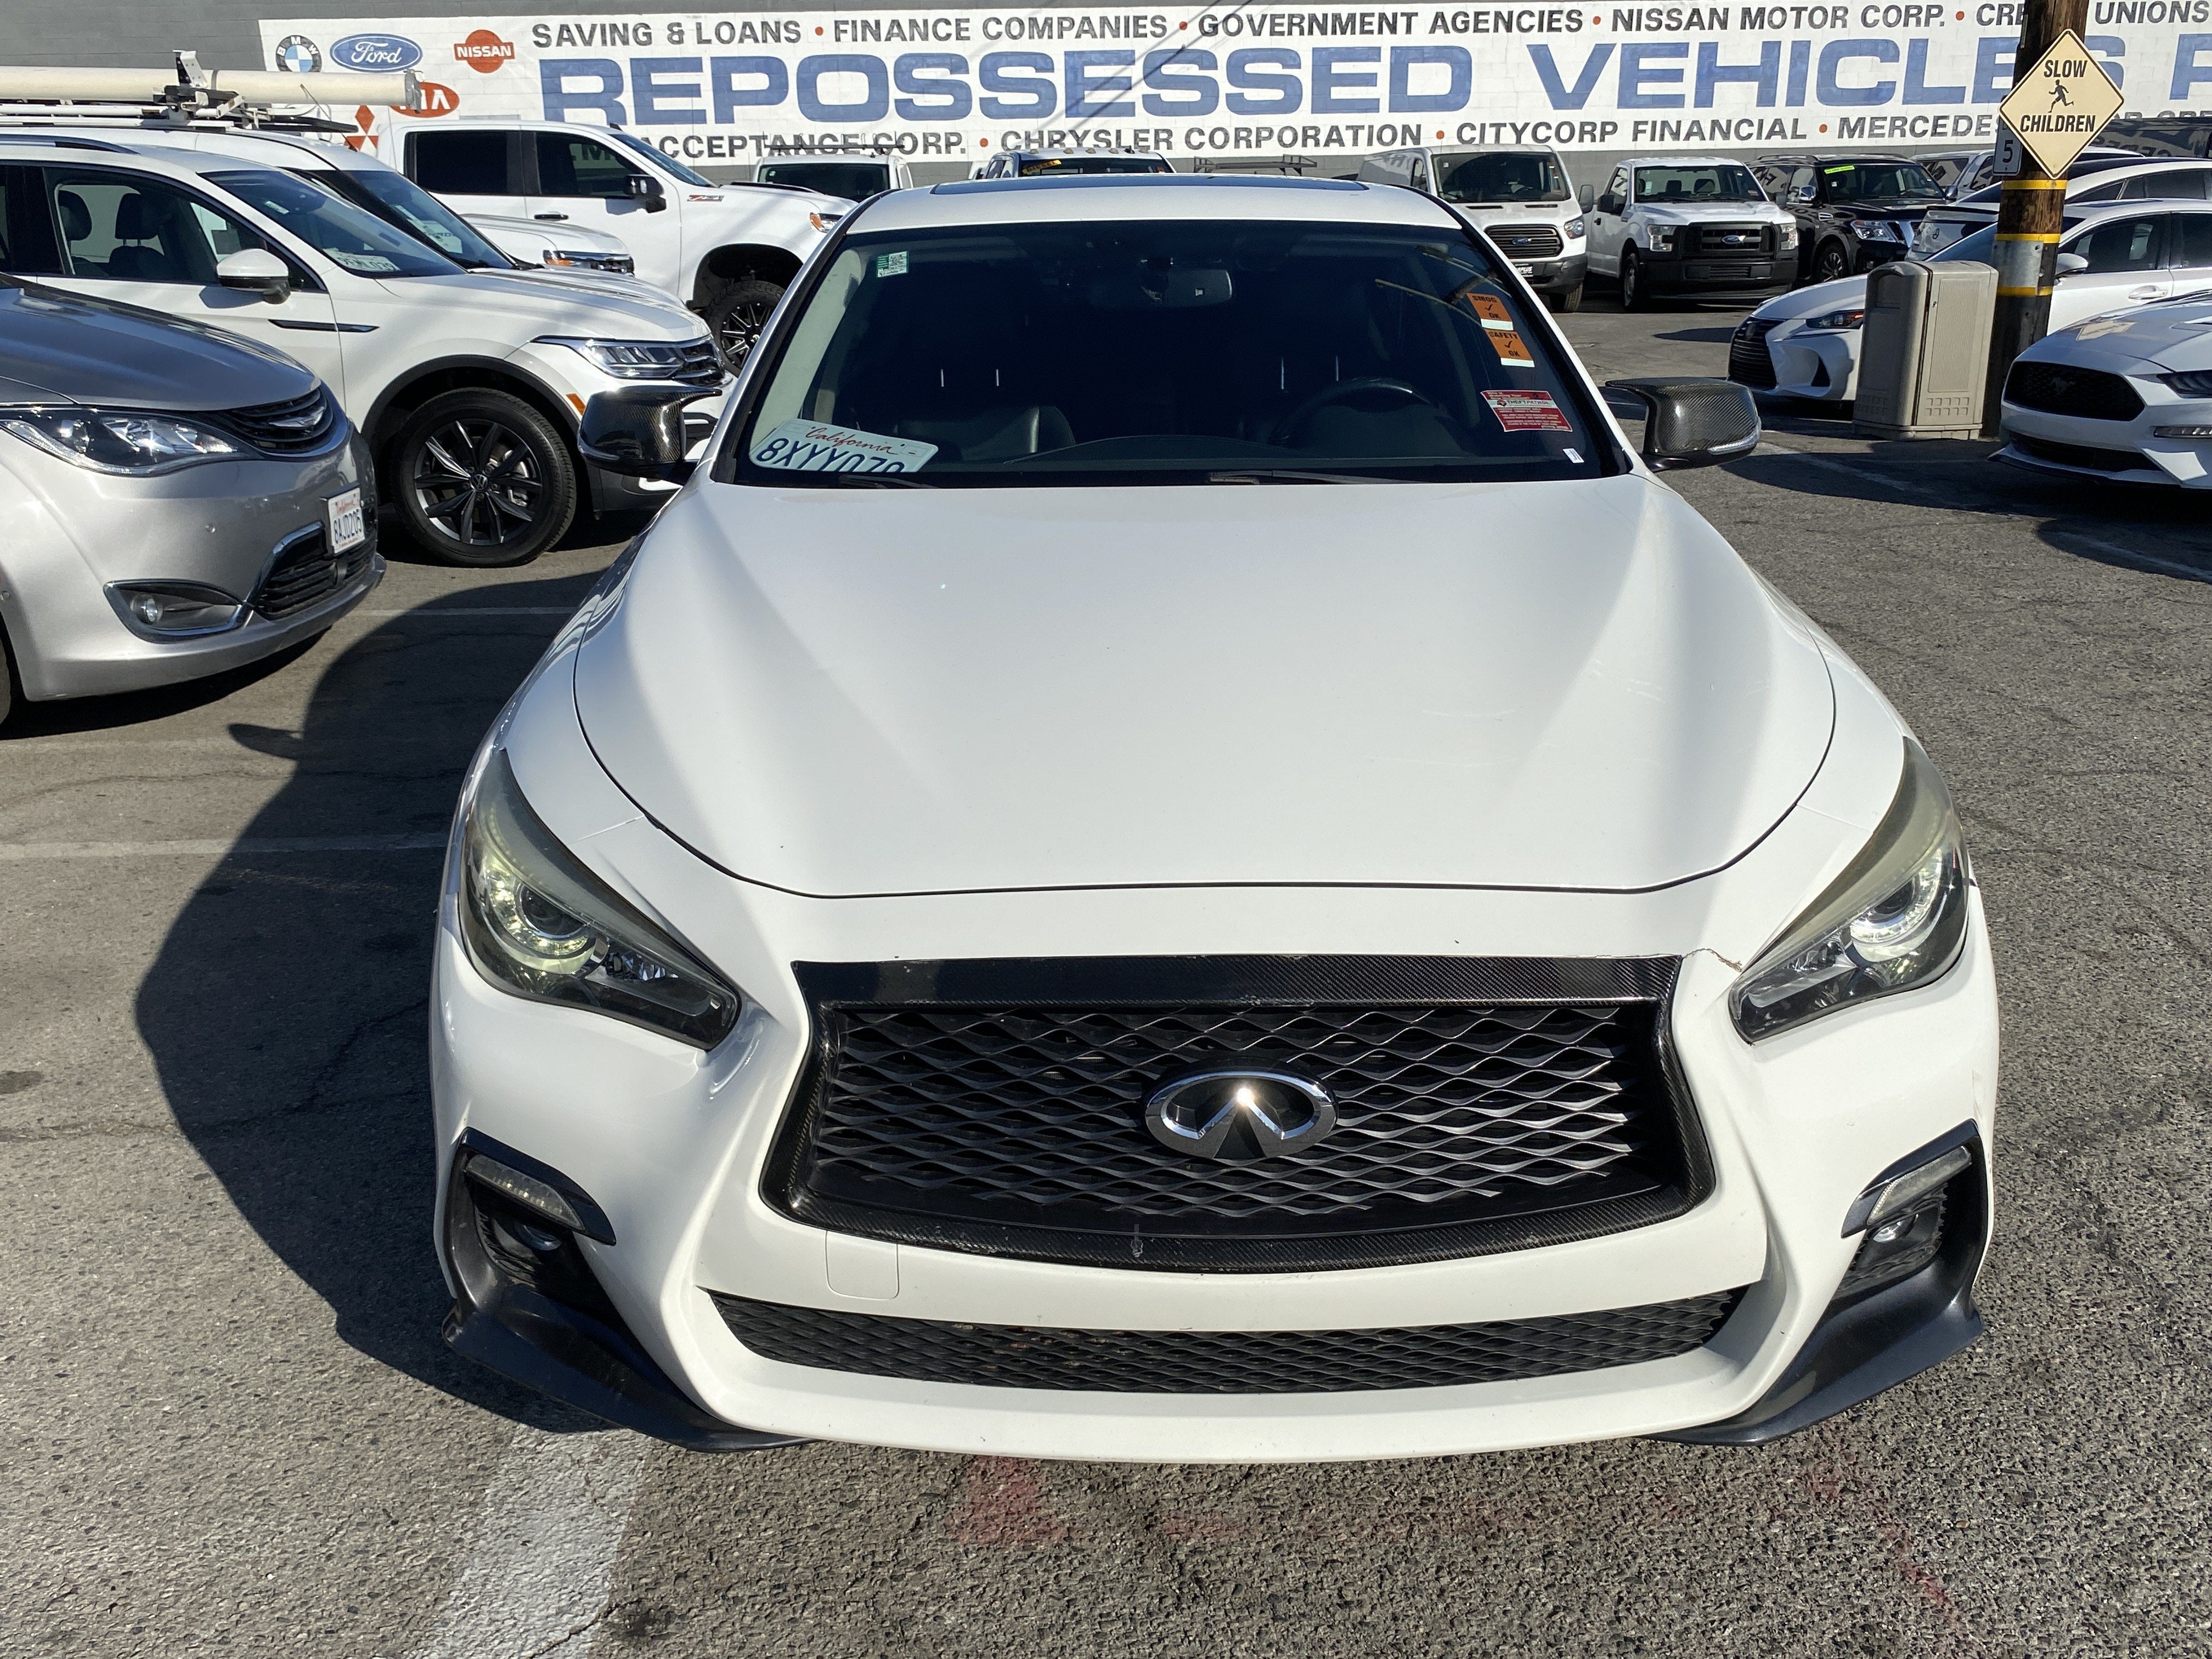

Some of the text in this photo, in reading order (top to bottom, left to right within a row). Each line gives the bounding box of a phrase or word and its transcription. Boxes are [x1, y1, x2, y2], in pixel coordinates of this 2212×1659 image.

[532, 22, 651, 48] SAVING
[667, 22, 686, 46] &
[696, 20, 801, 44] LOANS
[834, 18, 971, 43] FINANCE
[982, 15, 1167, 41] COMPANIES
[1198, 12, 1418, 38] GOVERNMENT
[1429, 9, 1583, 35] AGENCIES
[1611, 7, 1729, 32] NISSAN
[1740, 5, 1849, 30] MOTOR
[1860, 4, 1945, 28] CORP.
[2095, 1, 2210, 25] UNIONS
[276, 36, 319, 57] BMW
[351, 41, 403, 64] Ford
[456, 45, 511, 58] NISSAN
[2044, 60, 2088, 78] SLOW
[539, 46, 1472, 126] REPOSSESSED
[400, 89, 451, 110] IA
[2020, 114, 2096, 133] CHILDREN
[873, 132, 966, 156] CORP.
[1001, 128, 1173, 151] CHRYSLER
[1184, 124, 1421, 151] CORPORATION
[1456, 120, 1618, 146] CITYCORP
[1632, 117, 1807, 143] FINANCIAL
[1837, 114, 1999, 140] MERCEDE
[2002, 139, 2014, 163] 5
[1489, 331, 1518, 340] SAFETY
[805, 426, 899, 455] California
